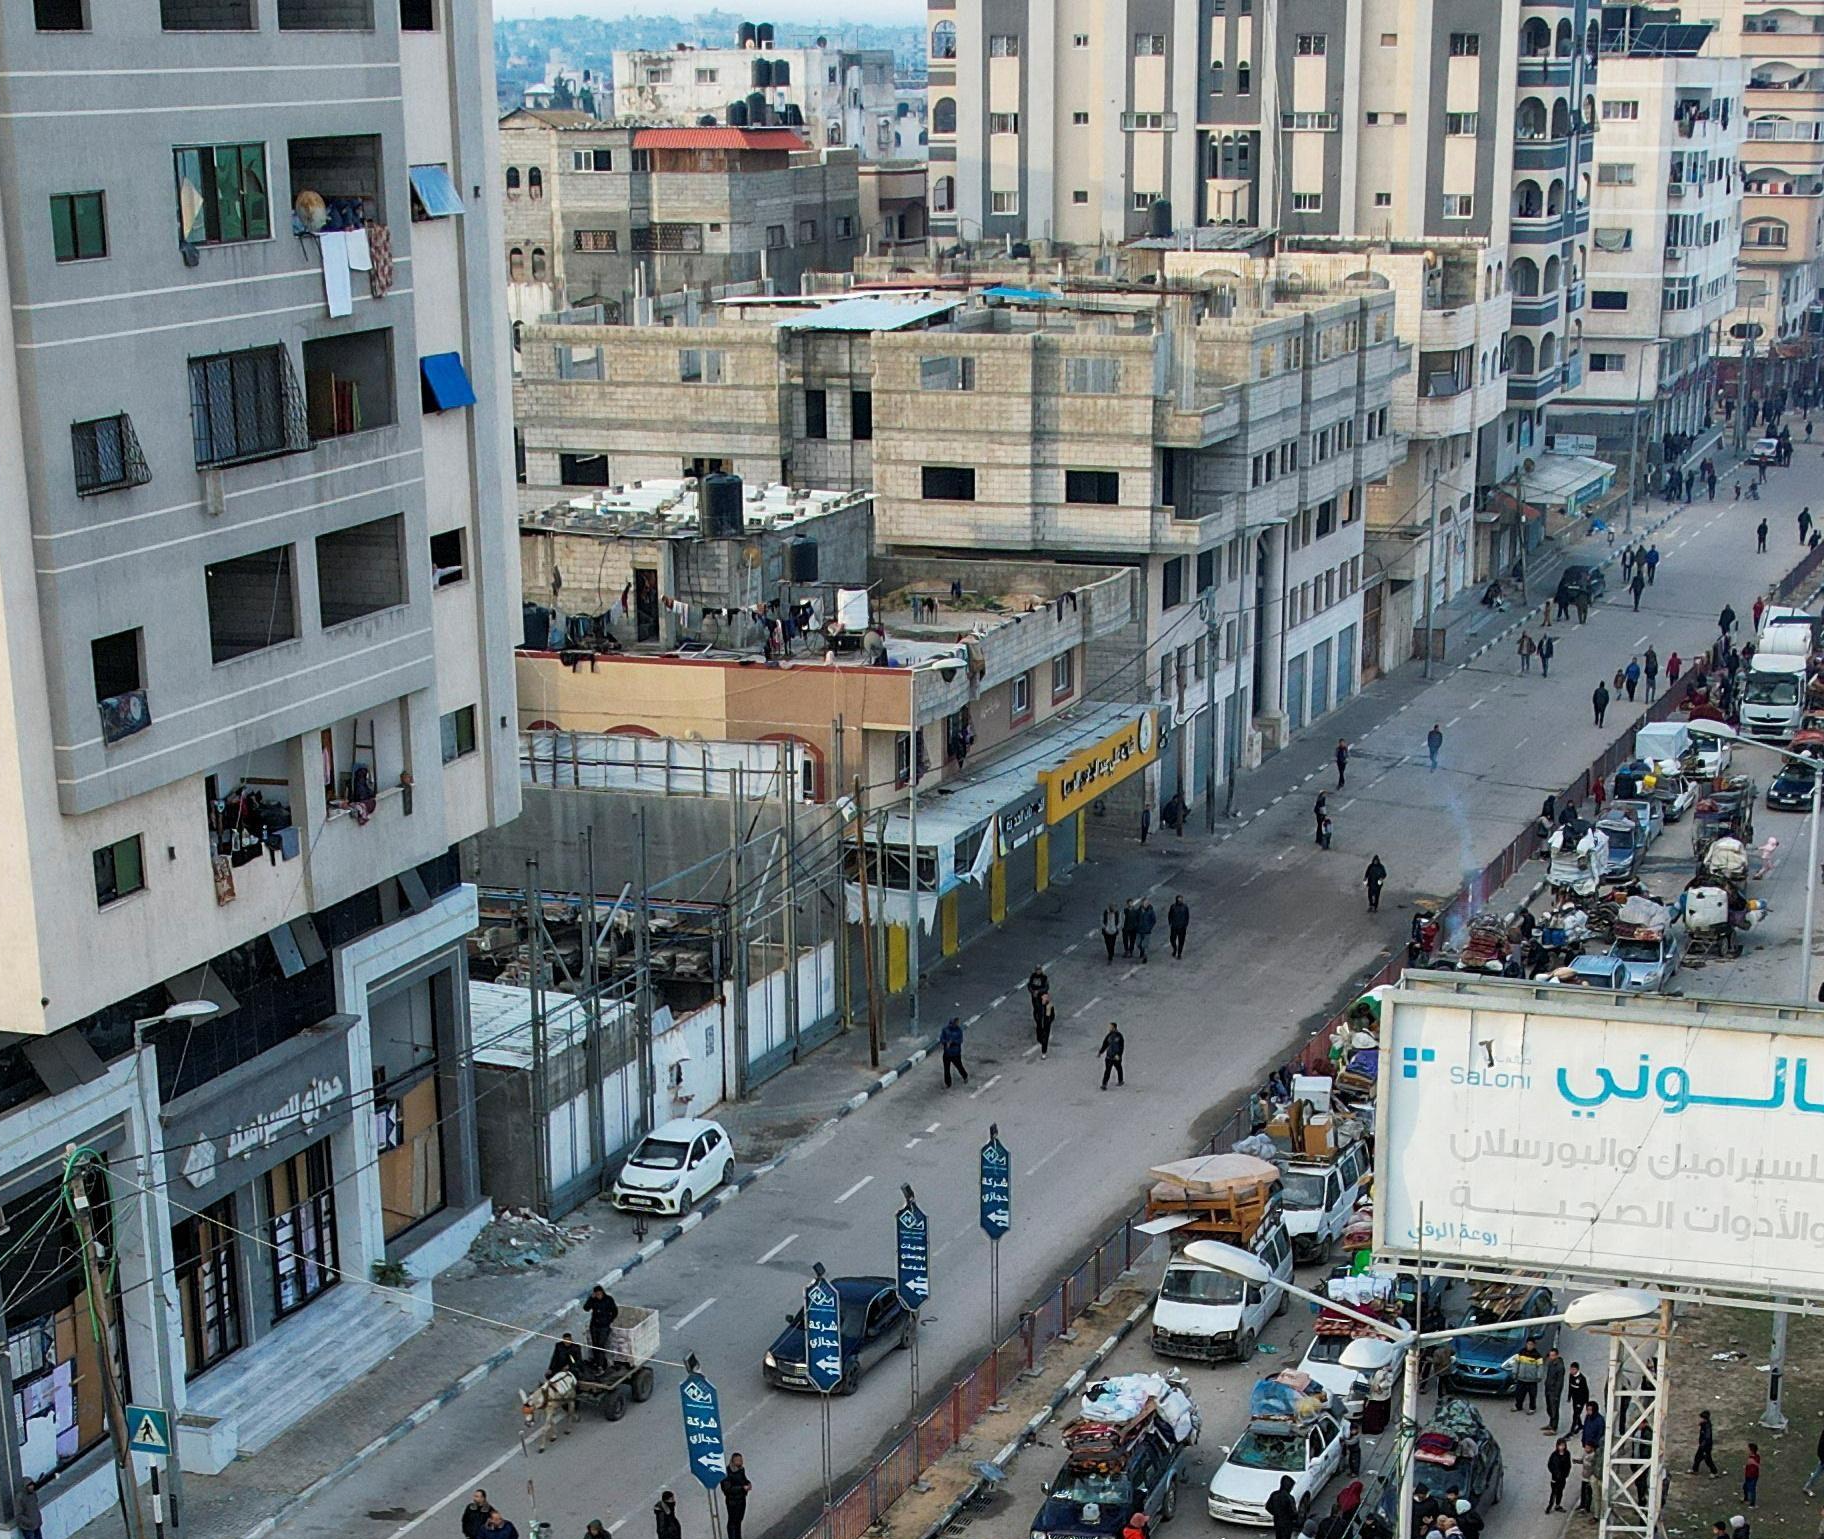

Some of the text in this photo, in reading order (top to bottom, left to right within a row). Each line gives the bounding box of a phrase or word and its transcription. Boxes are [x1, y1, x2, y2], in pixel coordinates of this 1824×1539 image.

[301, 1075, 344, 1136] حجازي
[1449, 1126, 1637, 1177] والبورسلان
[1449, 1179, 1670, 1234] الصحية
[1407, 1220, 1498, 1247] روعة الرقي
[808, 1320, 838, 1333] شركة
[809, 1336, 840, 1349] حجازي
[686, 1416, 718, 1429] شركة
[689, 1433, 721, 1445] حجازي
